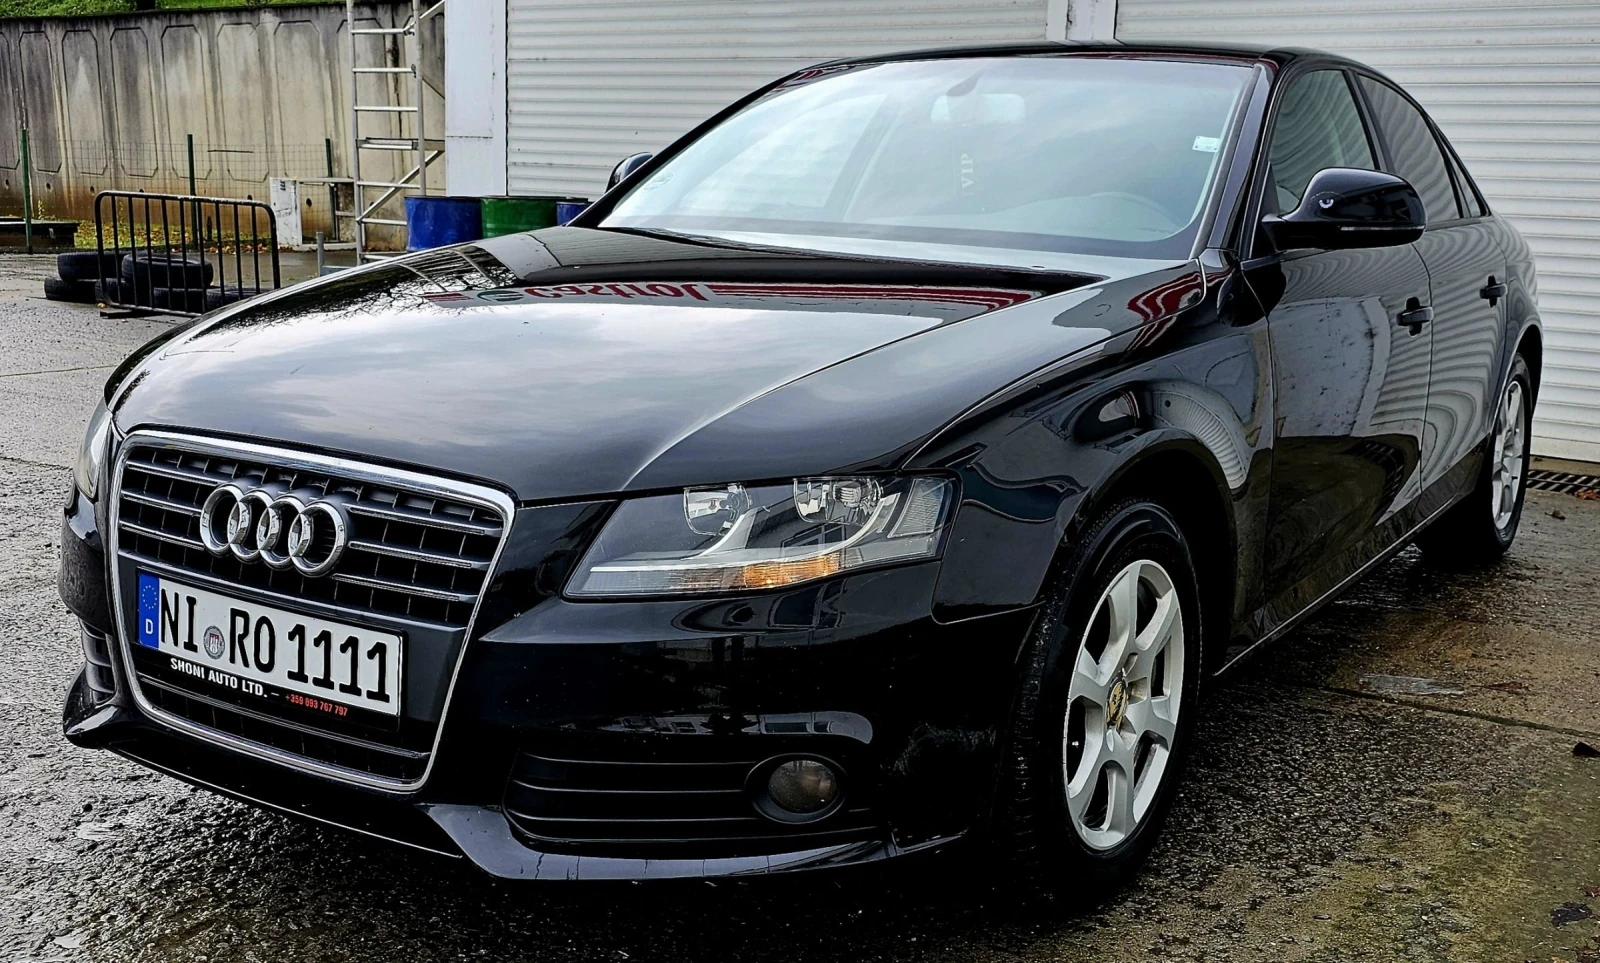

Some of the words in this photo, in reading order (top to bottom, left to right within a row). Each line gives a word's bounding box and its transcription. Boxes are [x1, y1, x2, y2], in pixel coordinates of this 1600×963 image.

[960, 152, 975, 190] VIP
[145, 618, 153, 635] D
[160, 588, 198, 653] NI
[229, 607, 276, 673] RO
[287, 623, 390, 703] 1111
[170, 658, 205, 679] SHONI
[208, 670, 238, 689] AUTO
[242, 680, 268, 698] LTD.
[320, 701, 333, 713] 767
[334, 705, 348, 717] 797
